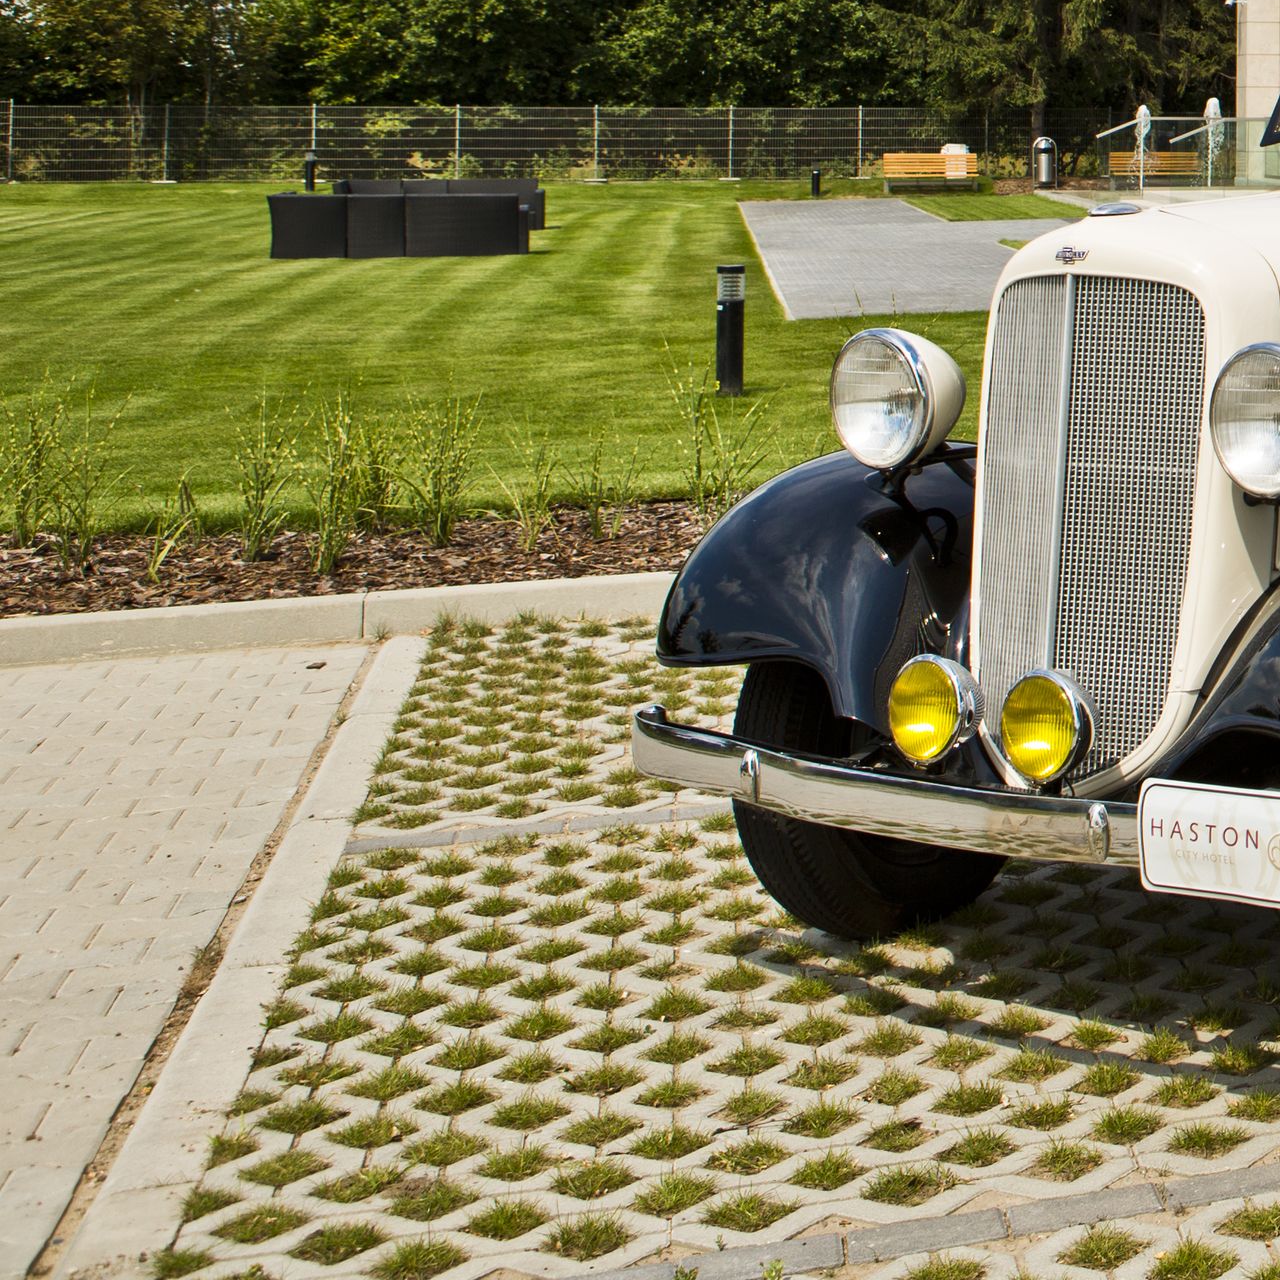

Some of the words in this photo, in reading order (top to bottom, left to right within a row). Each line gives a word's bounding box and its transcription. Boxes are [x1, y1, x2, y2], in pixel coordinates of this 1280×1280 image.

[1151, 817, 1259, 850] HASTON
[1175, 848, 1199, 861] CITY
[1202, 852, 1235, 866] HOTEL
